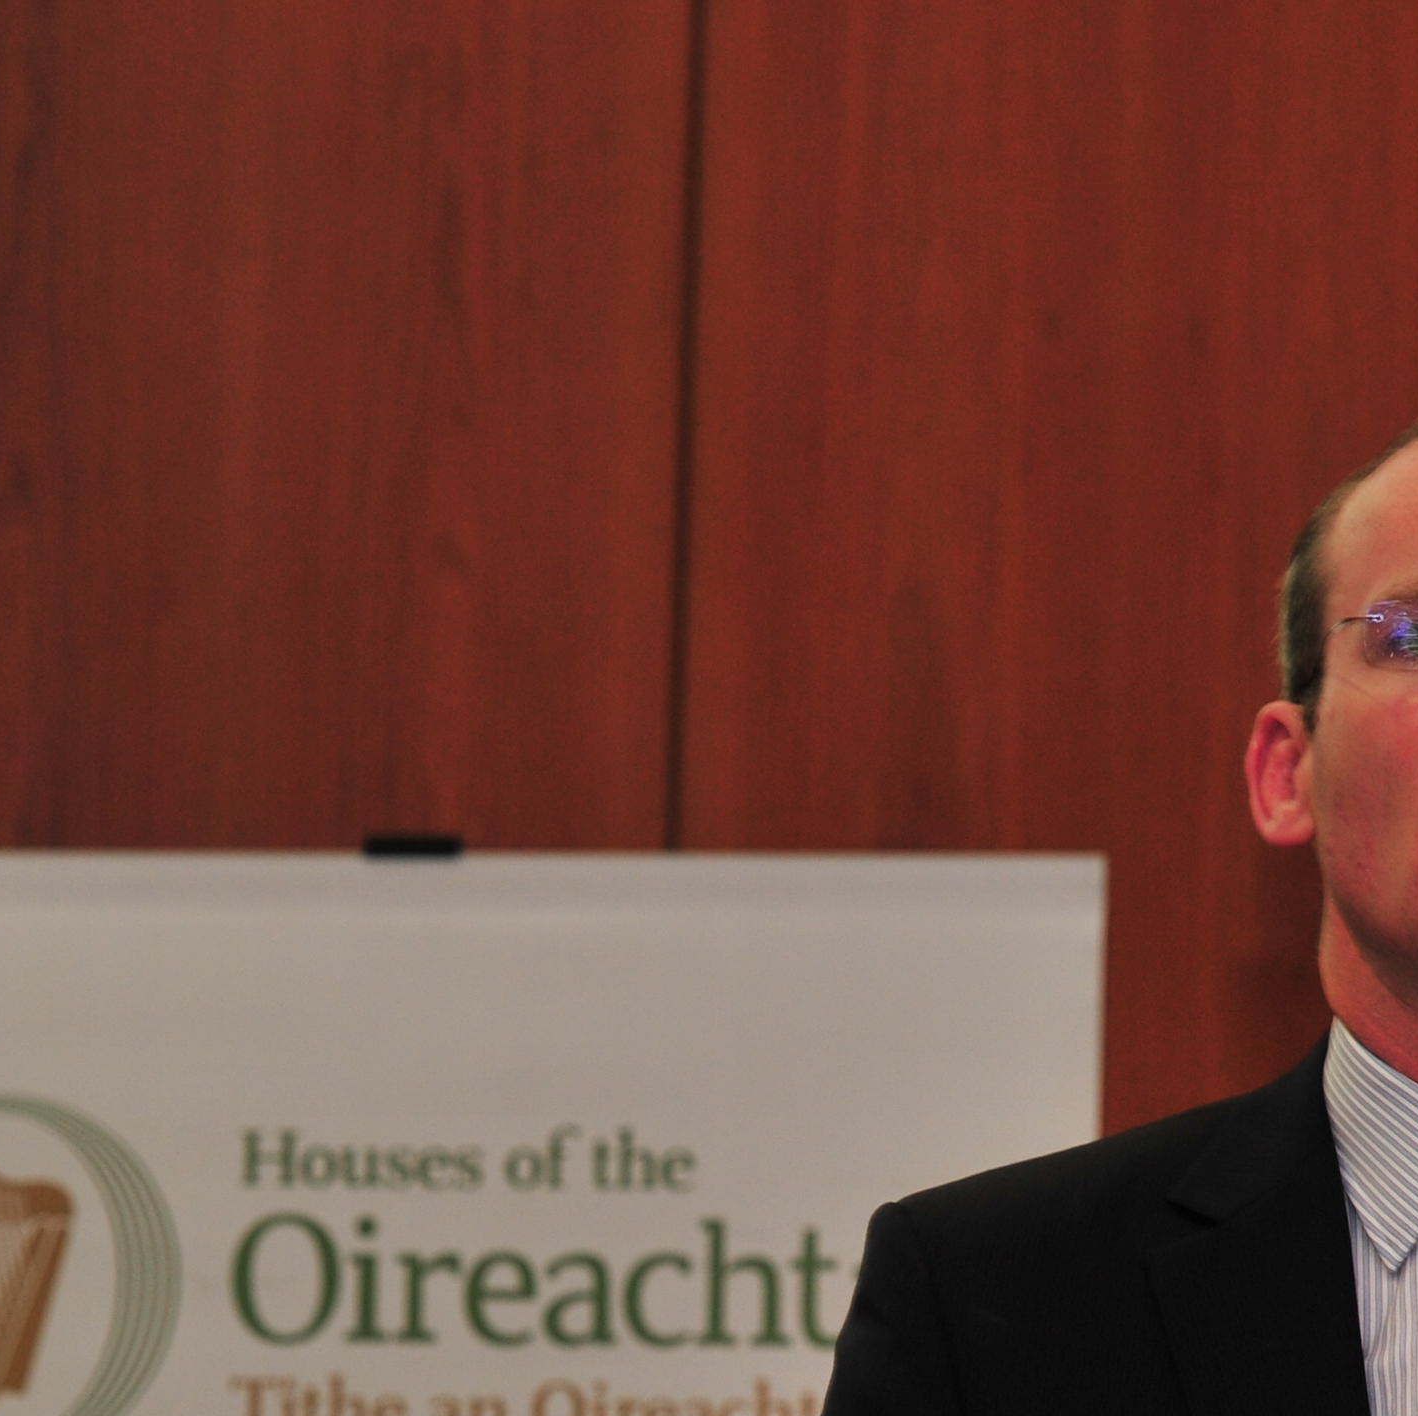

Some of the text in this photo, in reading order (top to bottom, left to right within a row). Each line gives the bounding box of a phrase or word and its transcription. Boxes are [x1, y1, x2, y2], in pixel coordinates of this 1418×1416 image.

[238, 1122, 697, 1193] Houses of the
[231, 1211, 863, 1348] Oireacht
